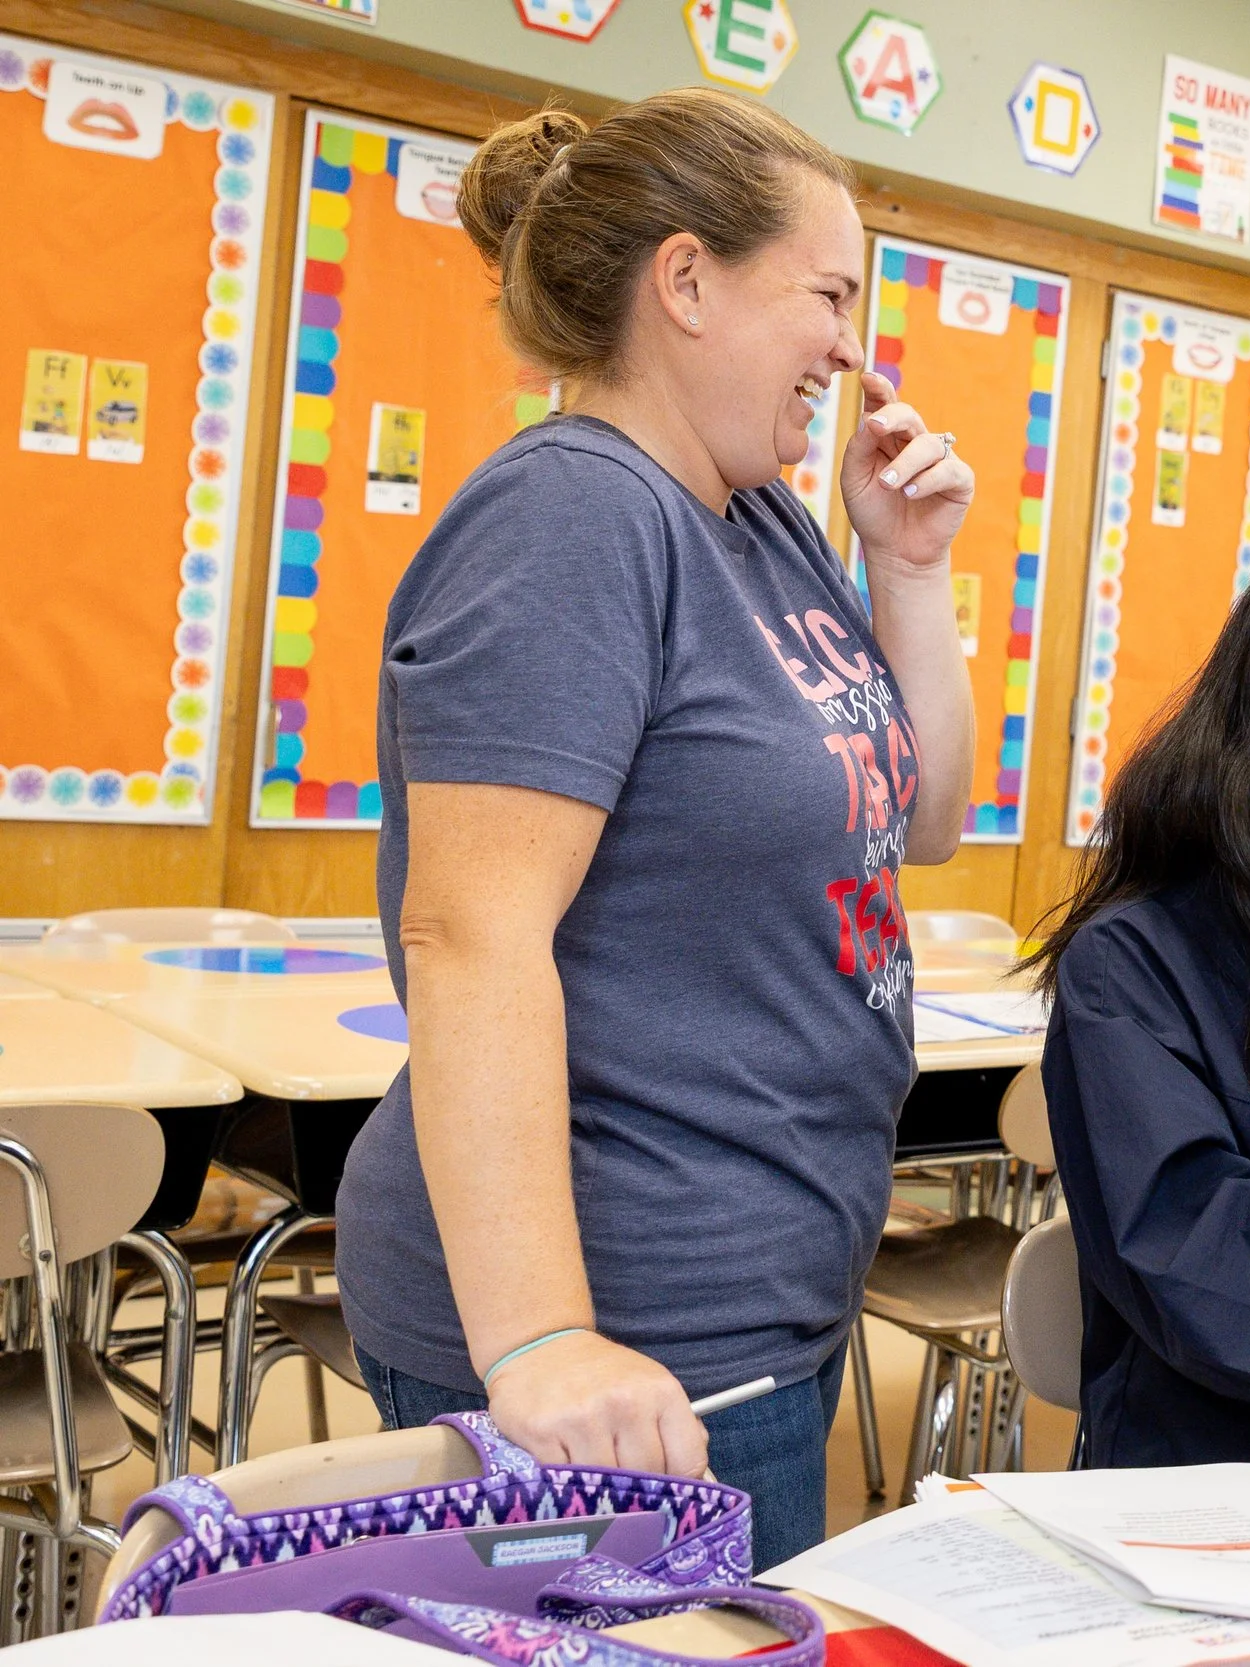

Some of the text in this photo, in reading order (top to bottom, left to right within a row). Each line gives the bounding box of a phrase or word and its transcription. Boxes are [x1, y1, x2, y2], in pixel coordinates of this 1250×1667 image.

[72, 71, 104, 87] Teeth
[1173, 74, 1199, 105] SO
[43, 355, 71, 379] Ff
[105, 365, 131, 388] Vv
[538, 1542, 579, 1554] JACKSON
